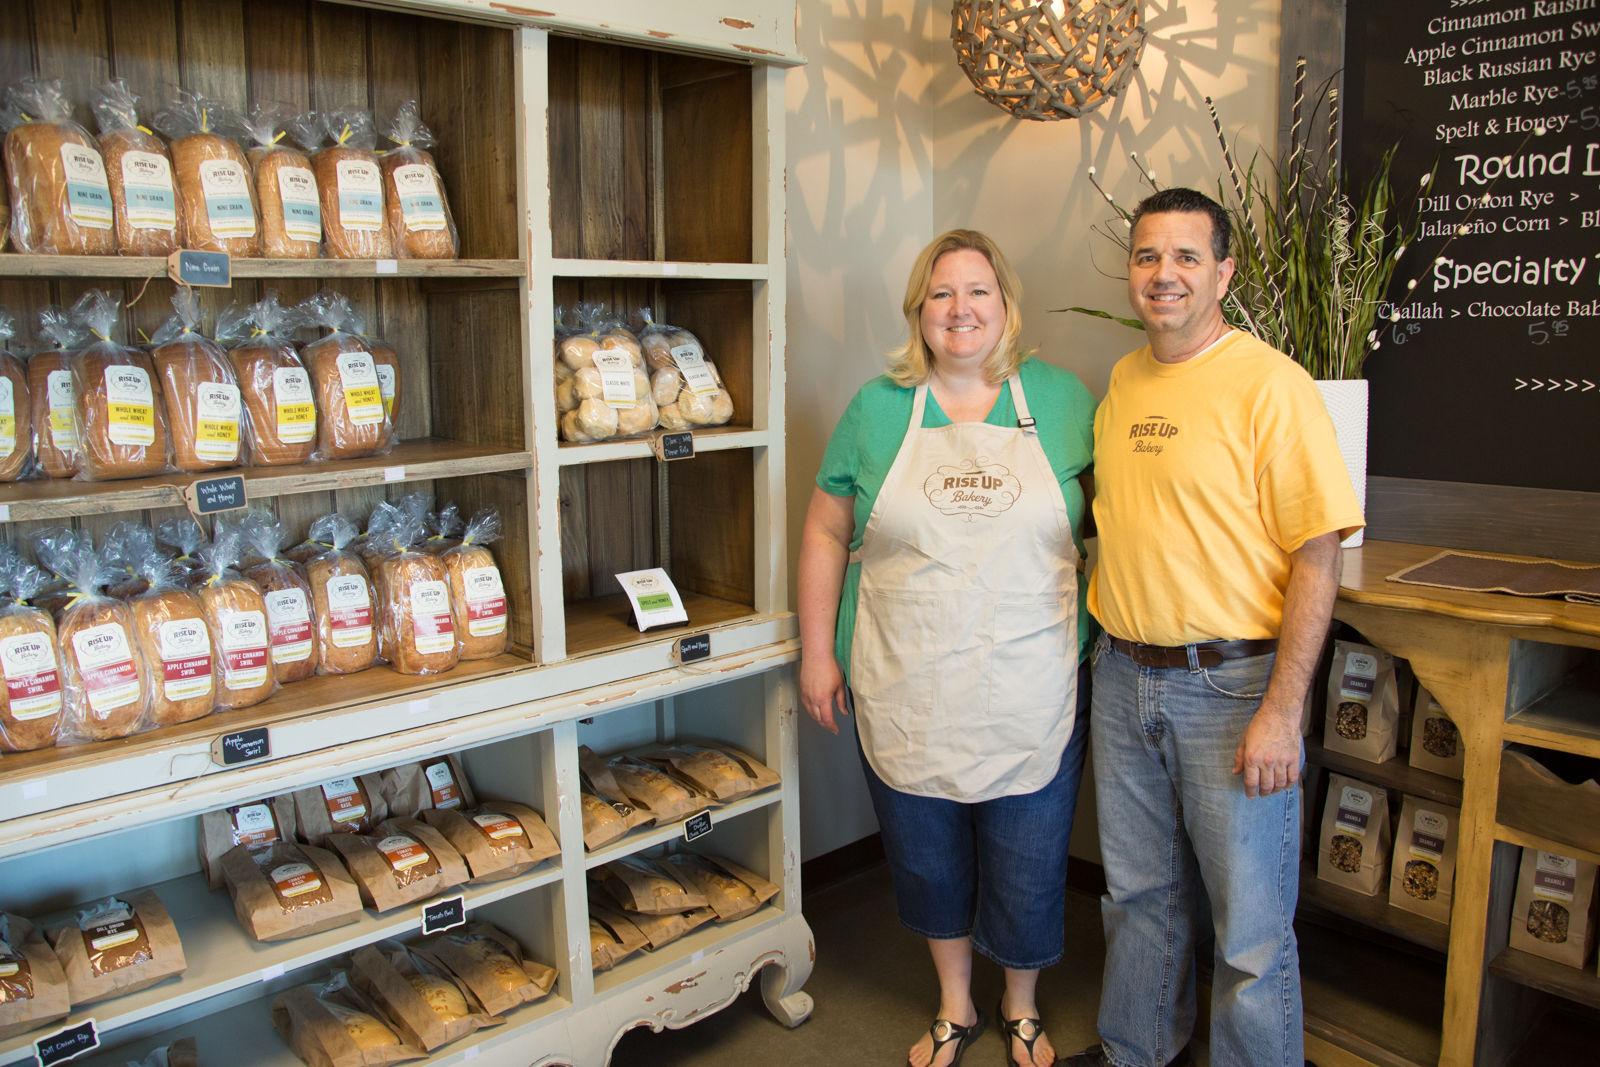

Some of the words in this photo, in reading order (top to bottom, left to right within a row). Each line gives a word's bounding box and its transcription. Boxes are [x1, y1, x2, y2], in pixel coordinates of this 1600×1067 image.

[1427, 6, 1526, 34] Cinnamon
[1533, 0, 1597, 18] Raisin
[1404, 43, 1456, 66] Apple
[1462, 28, 1564, 56] Cinnamon
[1424, 64, 1474, 86] Black
[1478, 57, 1552, 80] Russian
[1559, 50, 1596, 71] Rye
[1449, 88, 1518, 111] Marble
[1524, 85, 1559, 105] Rye
[1435, 120, 1480, 144] Spelt
[1484, 118, 1500, 136] &
[1506, 114, 1570, 134] Honey
[1454, 145, 1572, 186] Round
[1417, 194, 1450, 213] Dill
[1456, 193, 1513, 211] Onion
[1520, 190, 1554, 210] Rye
[1502, 216, 1550, 232] Corn
[1433, 256, 1586, 292] Specialty
[1378, 302, 1444, 320] Challah
[1467, 301, 1561, 318] Chocolate
[1129, 422, 1156, 439] RISE
[1158, 422, 1179, 439] UP
[1132, 440, 1164, 456] Bakery
[944, 477, 978, 490] RISE
[981, 476, 1004, 490] UP
[950, 491, 992, 506] Bakery
